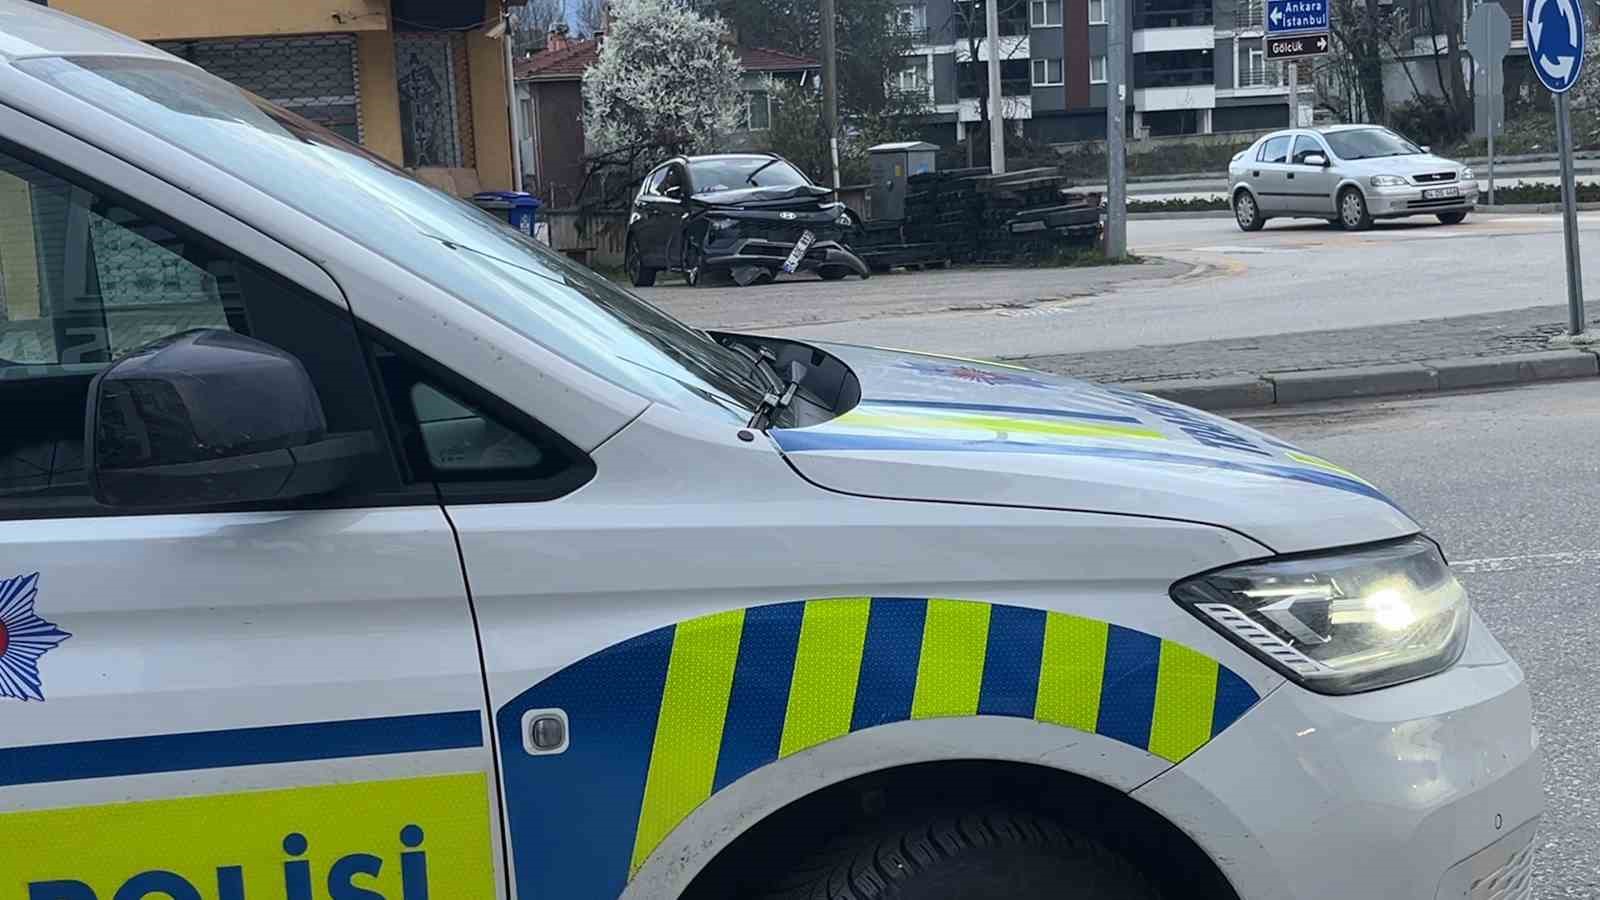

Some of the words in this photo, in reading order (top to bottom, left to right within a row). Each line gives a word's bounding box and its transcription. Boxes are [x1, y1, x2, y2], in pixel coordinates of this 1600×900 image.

[1285, 2, 1321, 12] Ankara
[1282, 14, 1326, 27] İstanbul
[28, 824, 429, 900] İSİ
